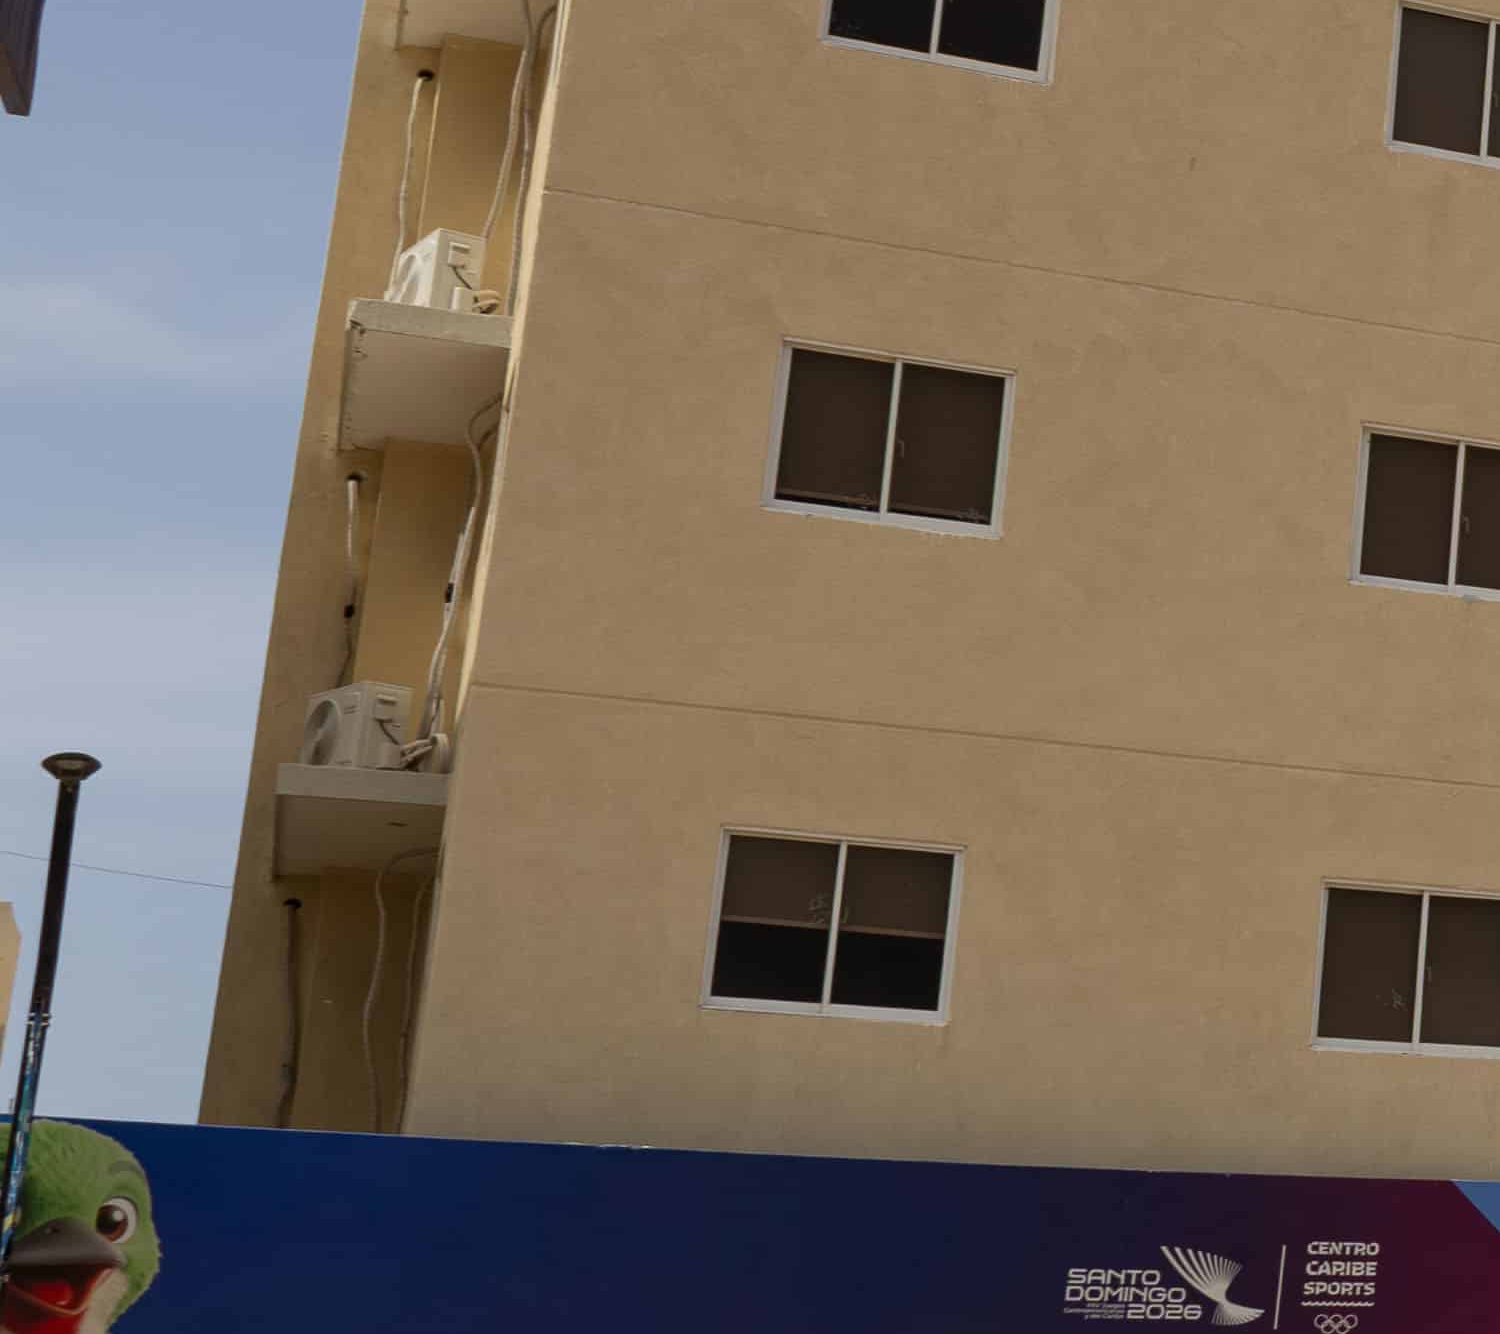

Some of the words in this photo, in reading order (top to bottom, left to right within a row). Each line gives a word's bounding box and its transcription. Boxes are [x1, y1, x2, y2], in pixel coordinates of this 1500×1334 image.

[1307, 1241, 1380, 1256] CENTRO
[1305, 1261, 1378, 1276] CARIBE
[1067, 1268, 1161, 1286] SANTO
[1064, 1285, 1187, 1303] DOMINGO
[1303, 1282, 1375, 1296] SPORTS
[1126, 1304, 1202, 1320] 2026
